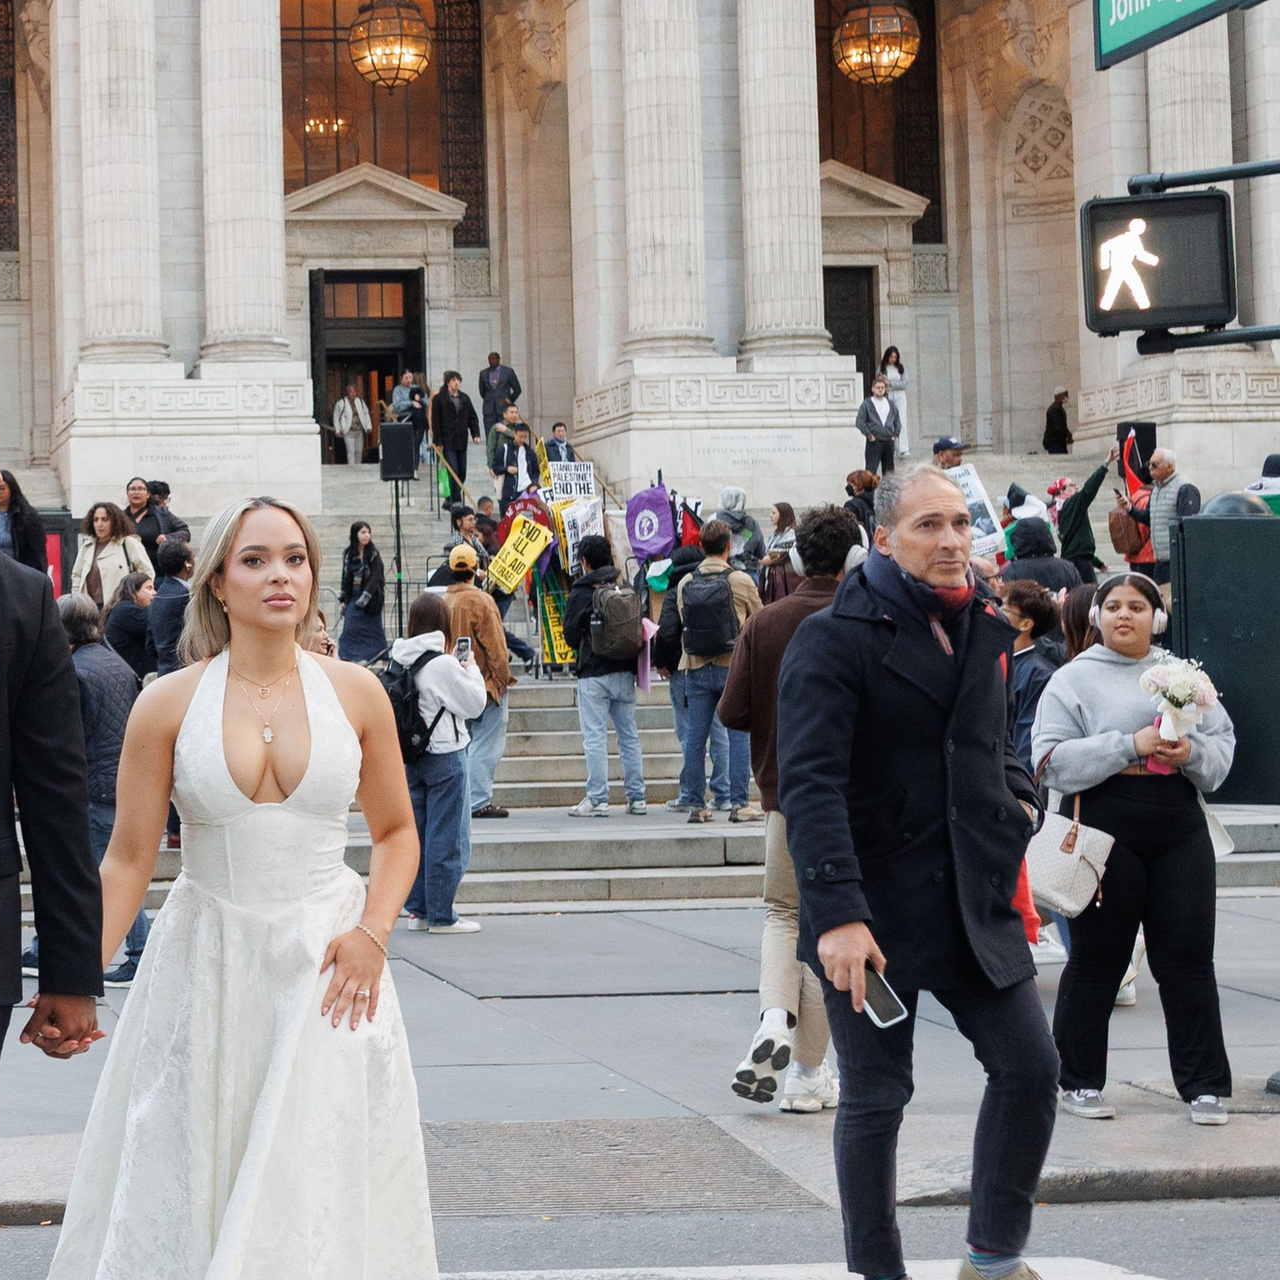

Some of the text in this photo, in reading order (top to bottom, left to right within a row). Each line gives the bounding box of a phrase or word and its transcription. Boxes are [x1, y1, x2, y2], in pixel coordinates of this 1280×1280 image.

[696, 447, 736, 455] STEPHEN
[746, 446, 808, 454] SCHWARZMAN
[551, 463, 591, 472] STAND WITH
[552, 472, 592, 482] PALESTINE!
[553, 482, 594, 495] END THE
[520, 519, 541, 543] END
[511, 535, 529, 556] ALL
[508, 558, 526, 575] AID
